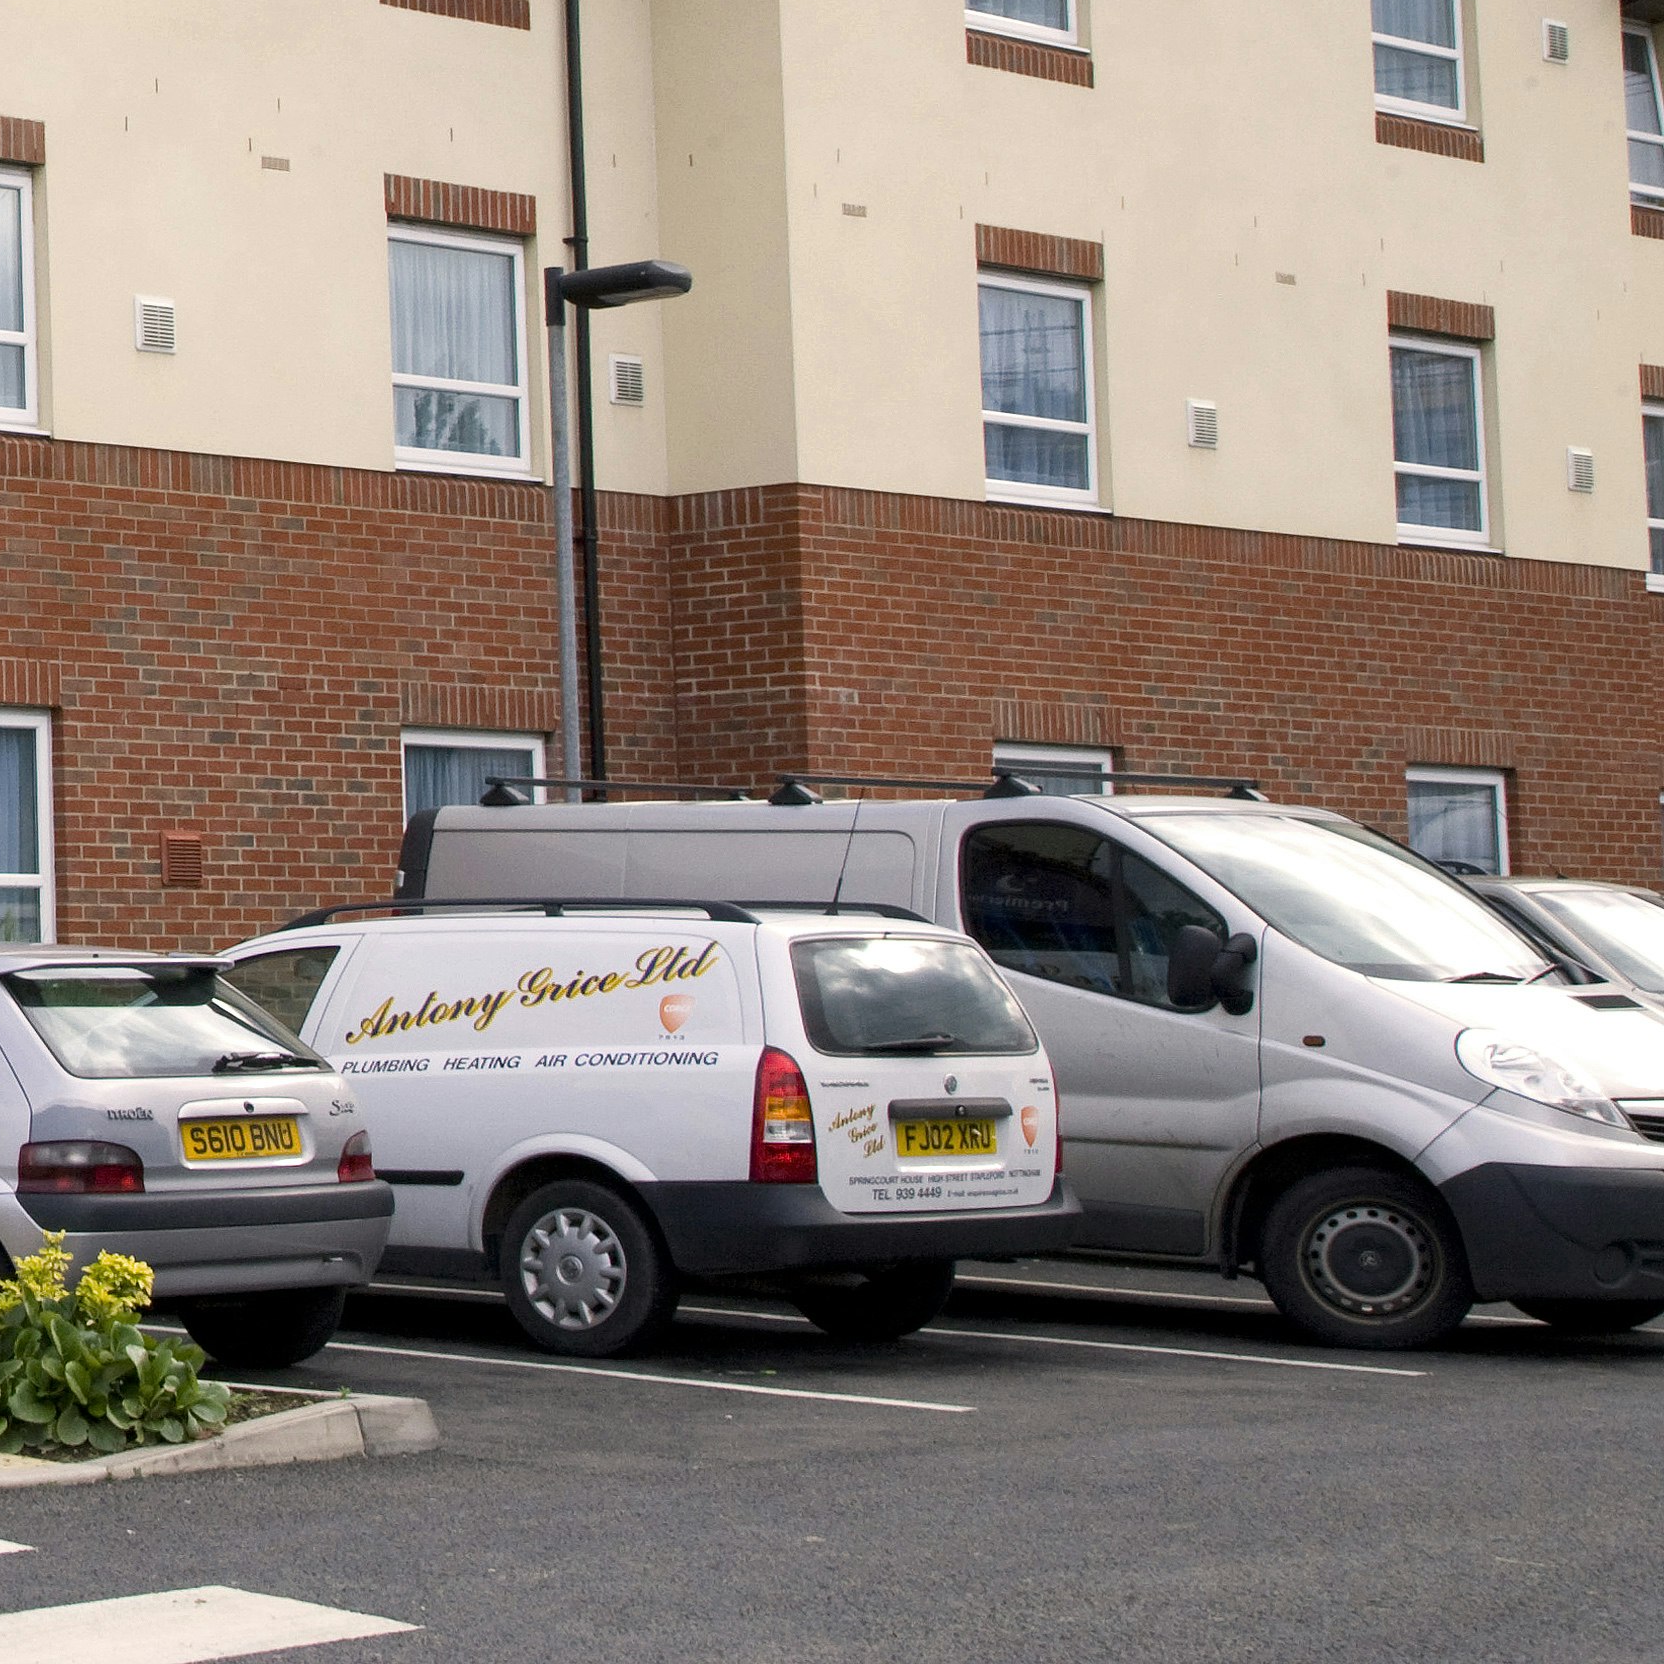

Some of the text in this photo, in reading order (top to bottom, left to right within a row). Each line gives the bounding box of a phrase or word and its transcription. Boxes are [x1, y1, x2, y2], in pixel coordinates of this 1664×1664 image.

[345, 940, 720, 1046] Antony Grice Ltd
[341, 1051, 720, 1075] PLUMBING HEATING AIR CONDITIONING
[828, 1104, 876, 1132] Antony
[190, 1122, 294, 1155] S610 BNU
[863, 1135, 886, 1158] Ltd
[904, 1123, 991, 1151] FJ02 XRU
[900, 1175, 923, 1184] HOUSE
[945, 1173, 968, 1183] STREET
[896, 1187, 915, 1200] 939
[917, 1186, 942, 1198] 4449
